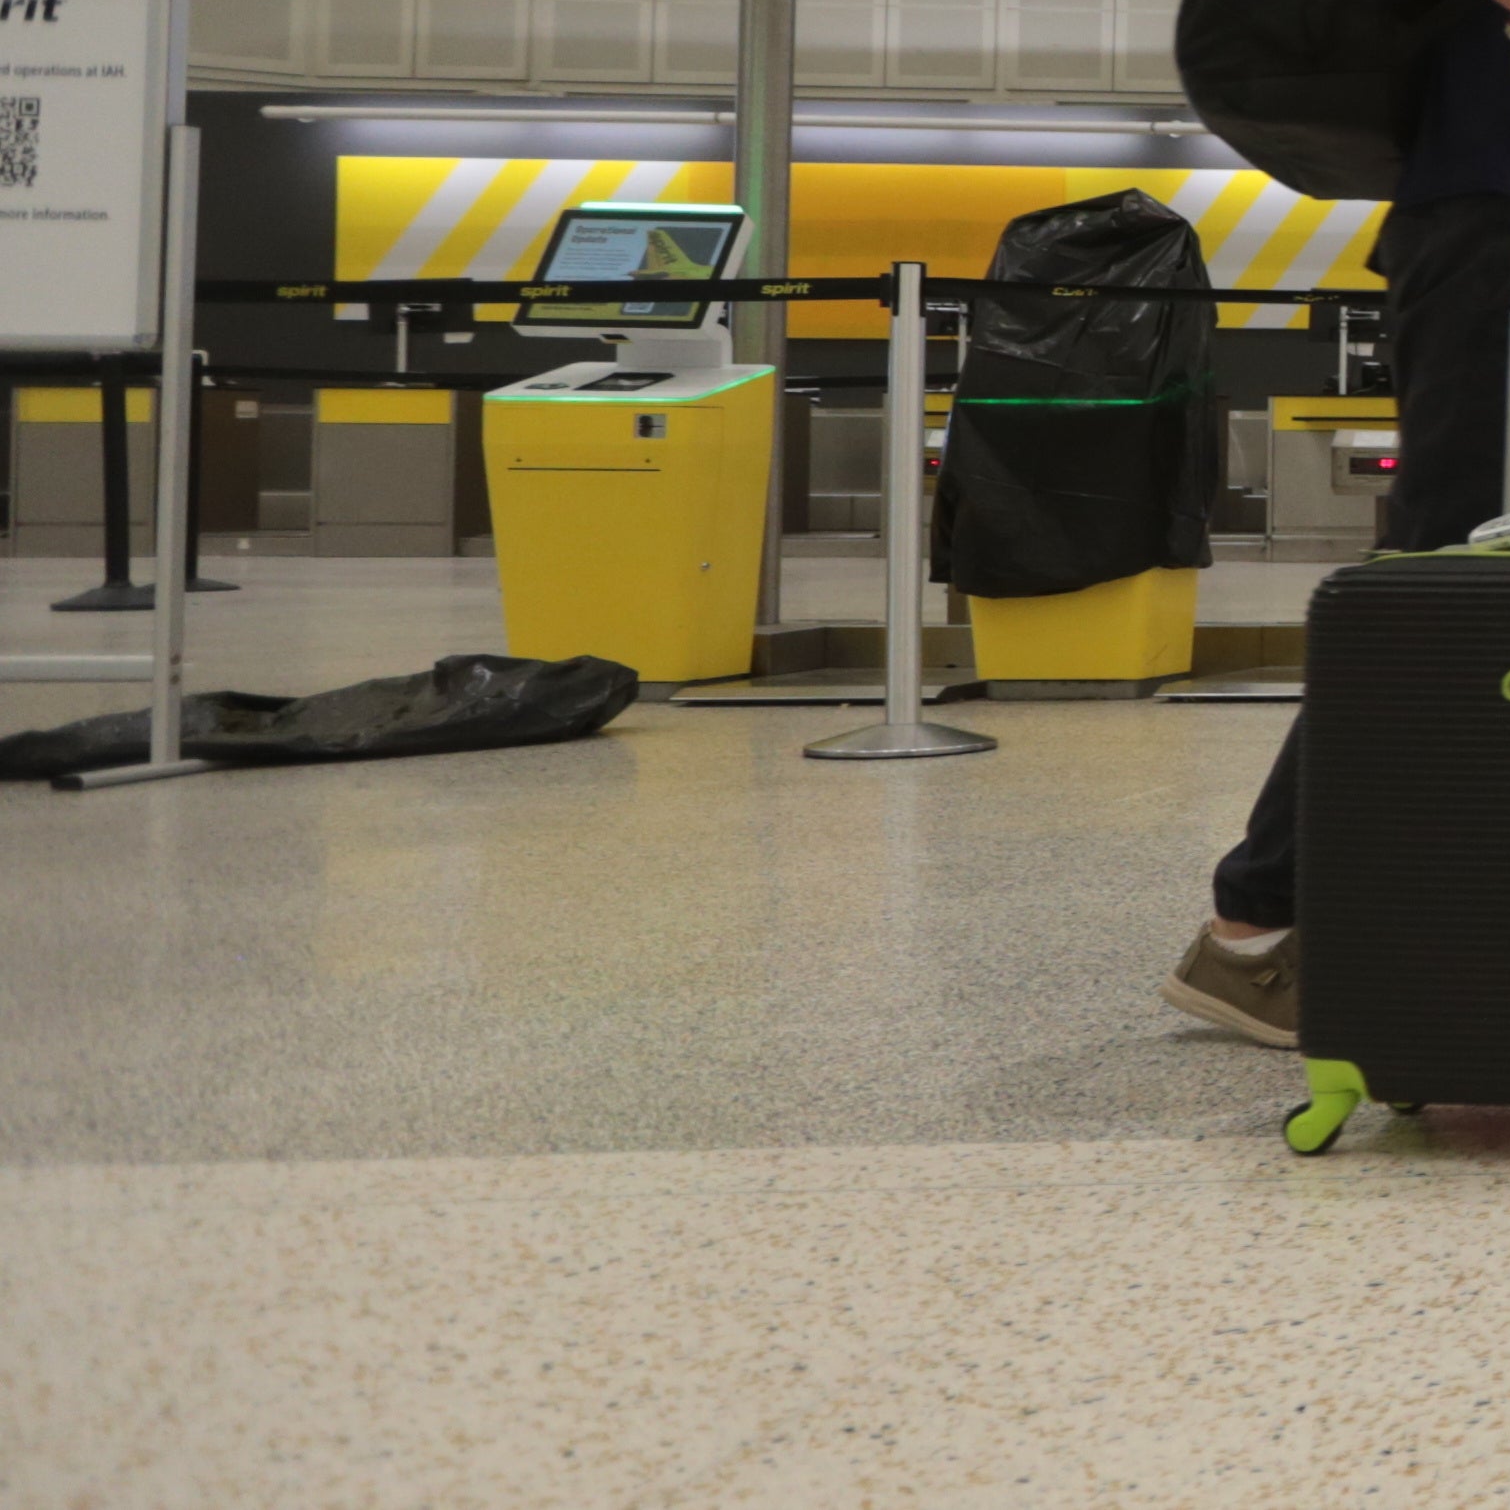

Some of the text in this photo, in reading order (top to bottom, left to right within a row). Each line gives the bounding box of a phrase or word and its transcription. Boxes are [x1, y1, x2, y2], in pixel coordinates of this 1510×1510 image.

[14, 64, 82, 80] operations
[85, 65, 98, 78] at
[520, 285, 571, 299] spirit
[761, 282, 812, 296] spirit
